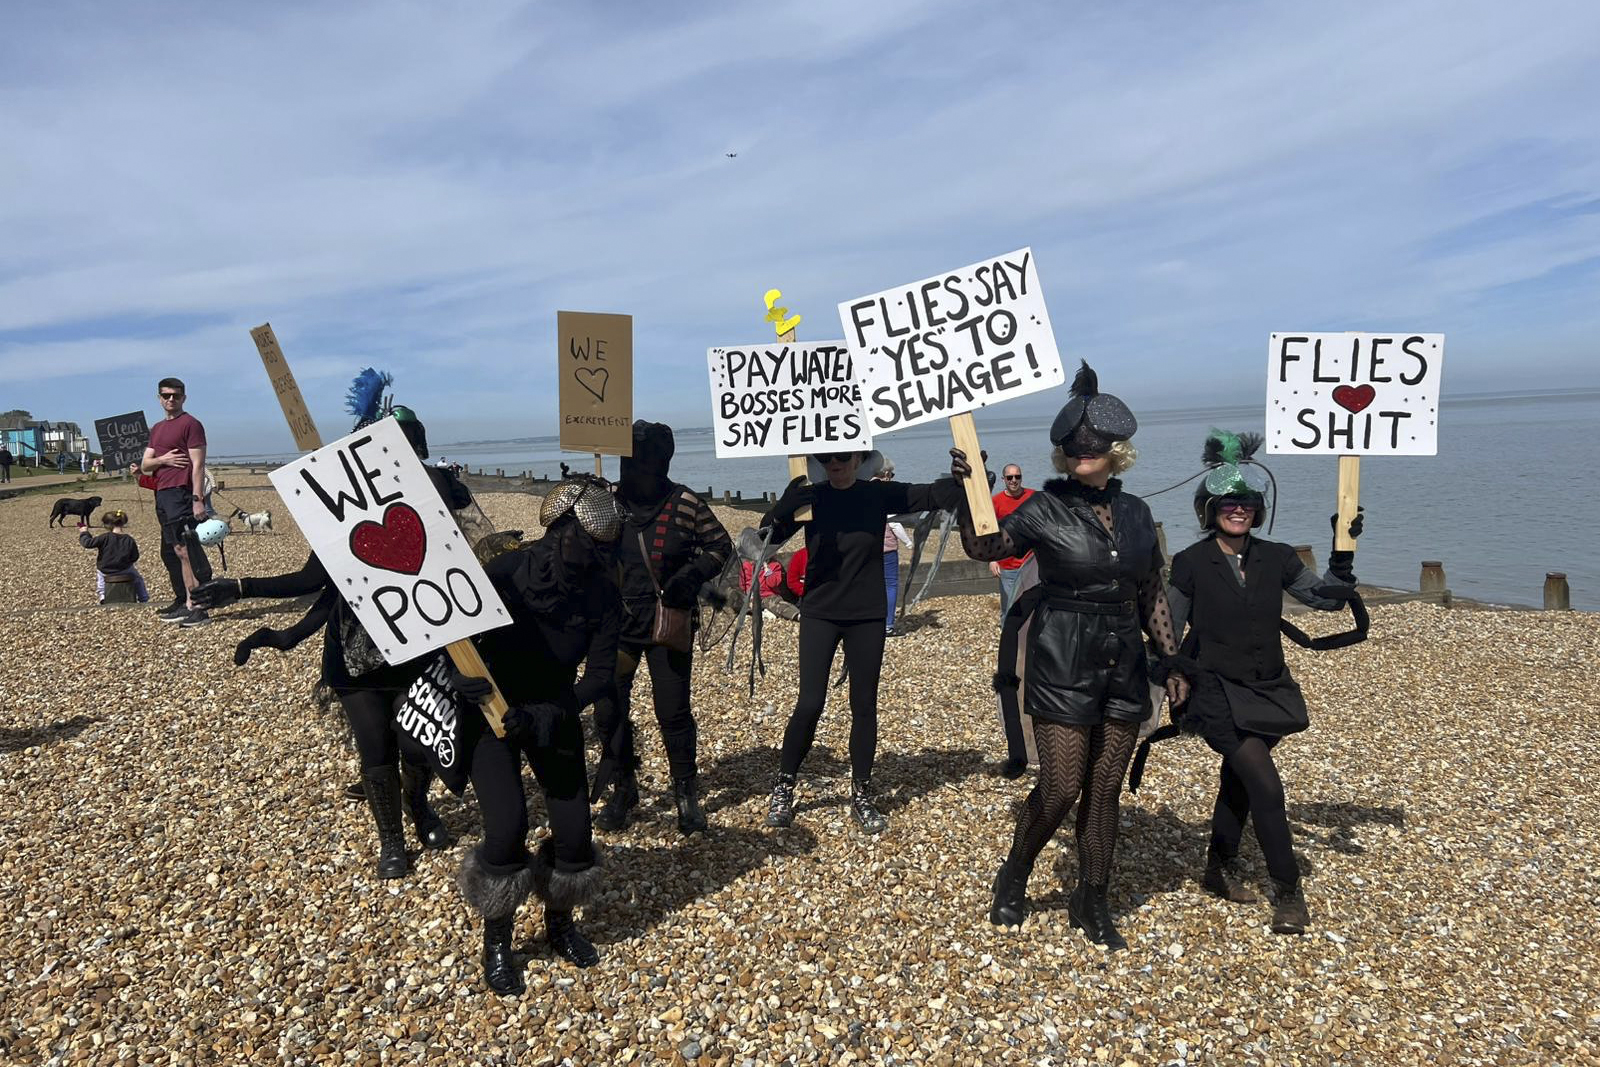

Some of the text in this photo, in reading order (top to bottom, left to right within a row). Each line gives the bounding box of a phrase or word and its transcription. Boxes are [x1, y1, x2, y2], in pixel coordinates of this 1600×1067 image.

[850, 252, 1030, 348] FLIES SAY
[569, 337, 608, 362] WE
[955, 309, 1018, 356] TO
[726, 347, 789, 388] PAY
[1279, 336, 1428, 386] FLIES
[565, 414, 630, 427] EXCREMENT
[721, 384, 862, 420] BOSSES MORE
[107, 421, 143, 438] Clean
[723, 413, 861, 448] SAY FLIES
[1291, 408, 1412, 449] SHIT
[114, 450, 145, 466] Pleas
[300, 435, 404, 523] WE
[371, 567, 483, 645] POO
